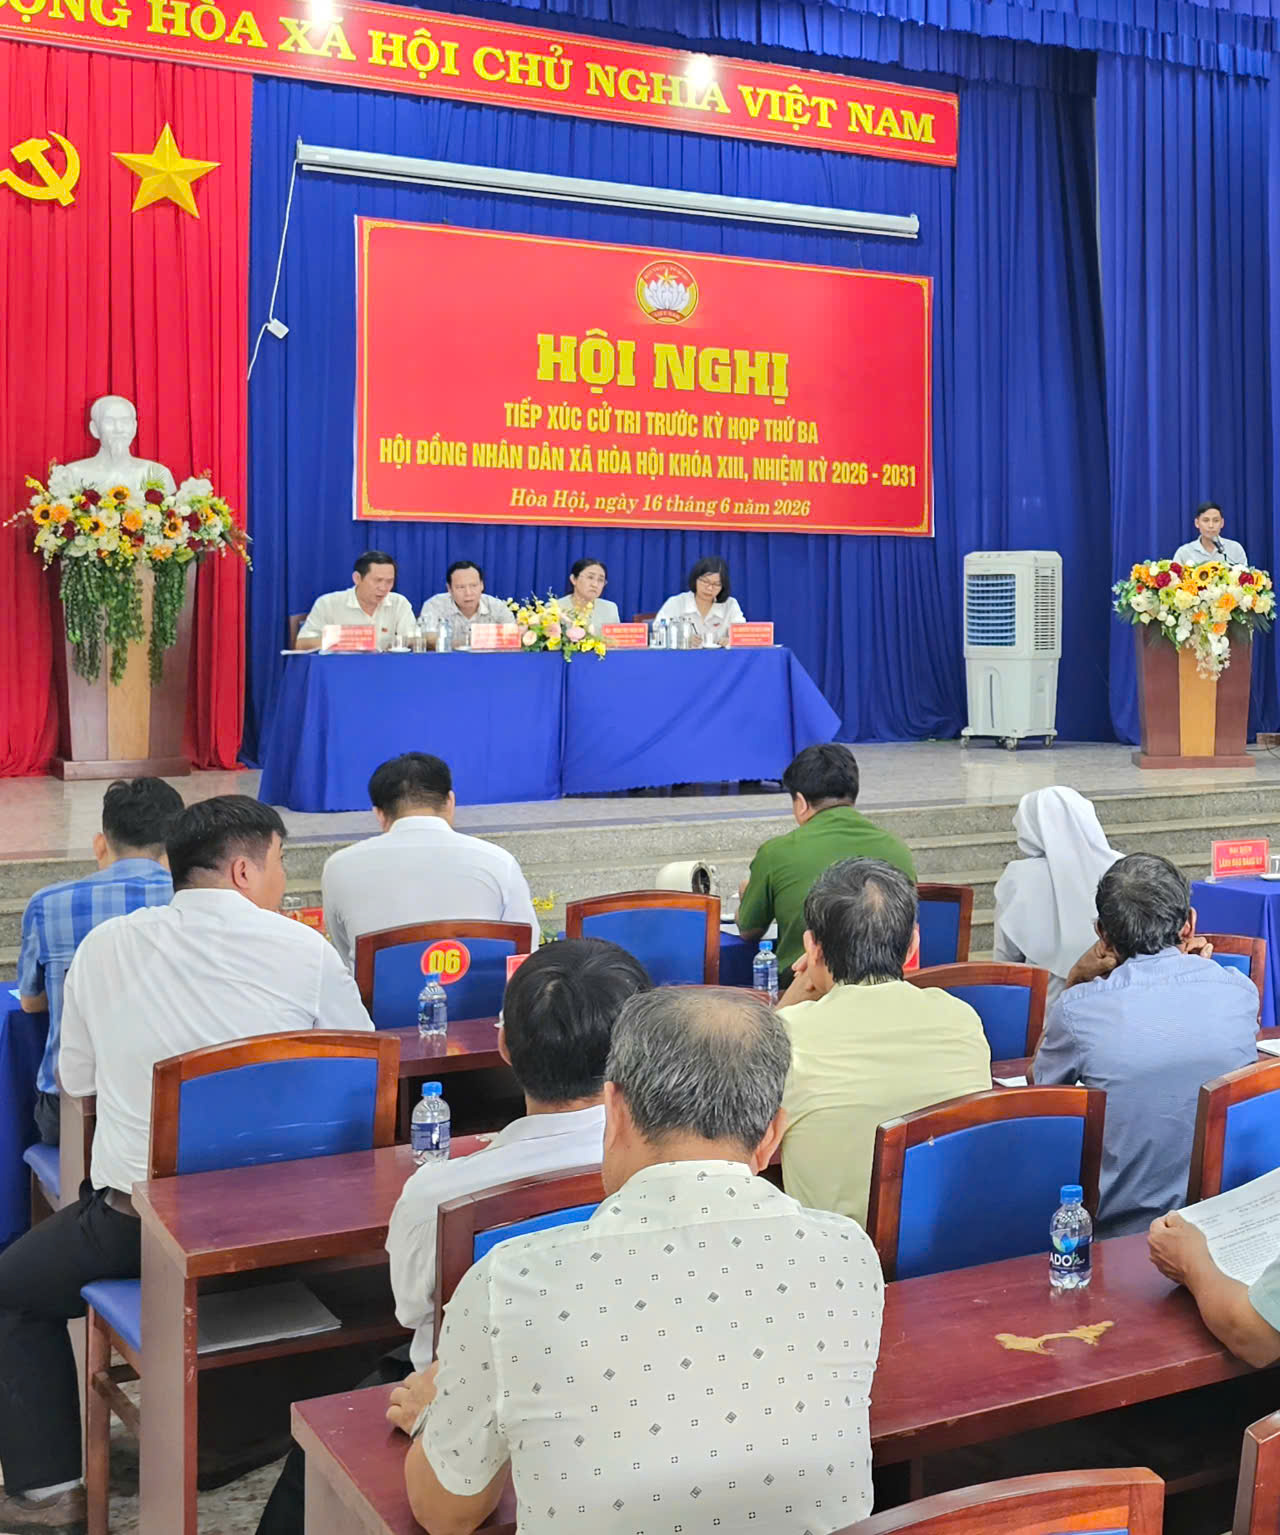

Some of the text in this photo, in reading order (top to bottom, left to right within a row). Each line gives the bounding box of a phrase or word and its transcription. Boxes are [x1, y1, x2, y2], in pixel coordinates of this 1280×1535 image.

[0, 0, 132, 28] NG
[146, 0, 268, 49] HÒA
[368, 27, 461, 80] HỘI
[472, 44, 574, 92] CHỦ
[738, 84, 838, 131] VIỆT
[848, 101, 936, 145] NAM
[537, 328, 788, 404] HỘI NGHỊ
[504, 397, 818, 444] TIẾP XÚC CỬ TRI TRƯỚC KỲ HỌP THỨ BA
[380, 434, 411, 469] HỘI
[416, 432, 467, 466] ĐỒNG
[472, 439, 523, 469] NHÂN
[528, 442, 564, 471] DÂN
[570, 444, 593, 472] XÃ
[597, 445, 632, 474] HÒA
[636, 448, 664, 480] HỘI
[669, 450, 712, 477] KHÓA
[717, 456, 748, 482] XIII,
[753, 454, 803, 486] NHIỆM
[808, 456, 828, 482] KỲ
[832, 461, 868, 485] 2026
[882, 464, 915, 487] 2031
[509, 487, 811, 517] Hòa Hội, ngày 16 tháng 6 năm 2026
[428, 949, 461, 975] 06
